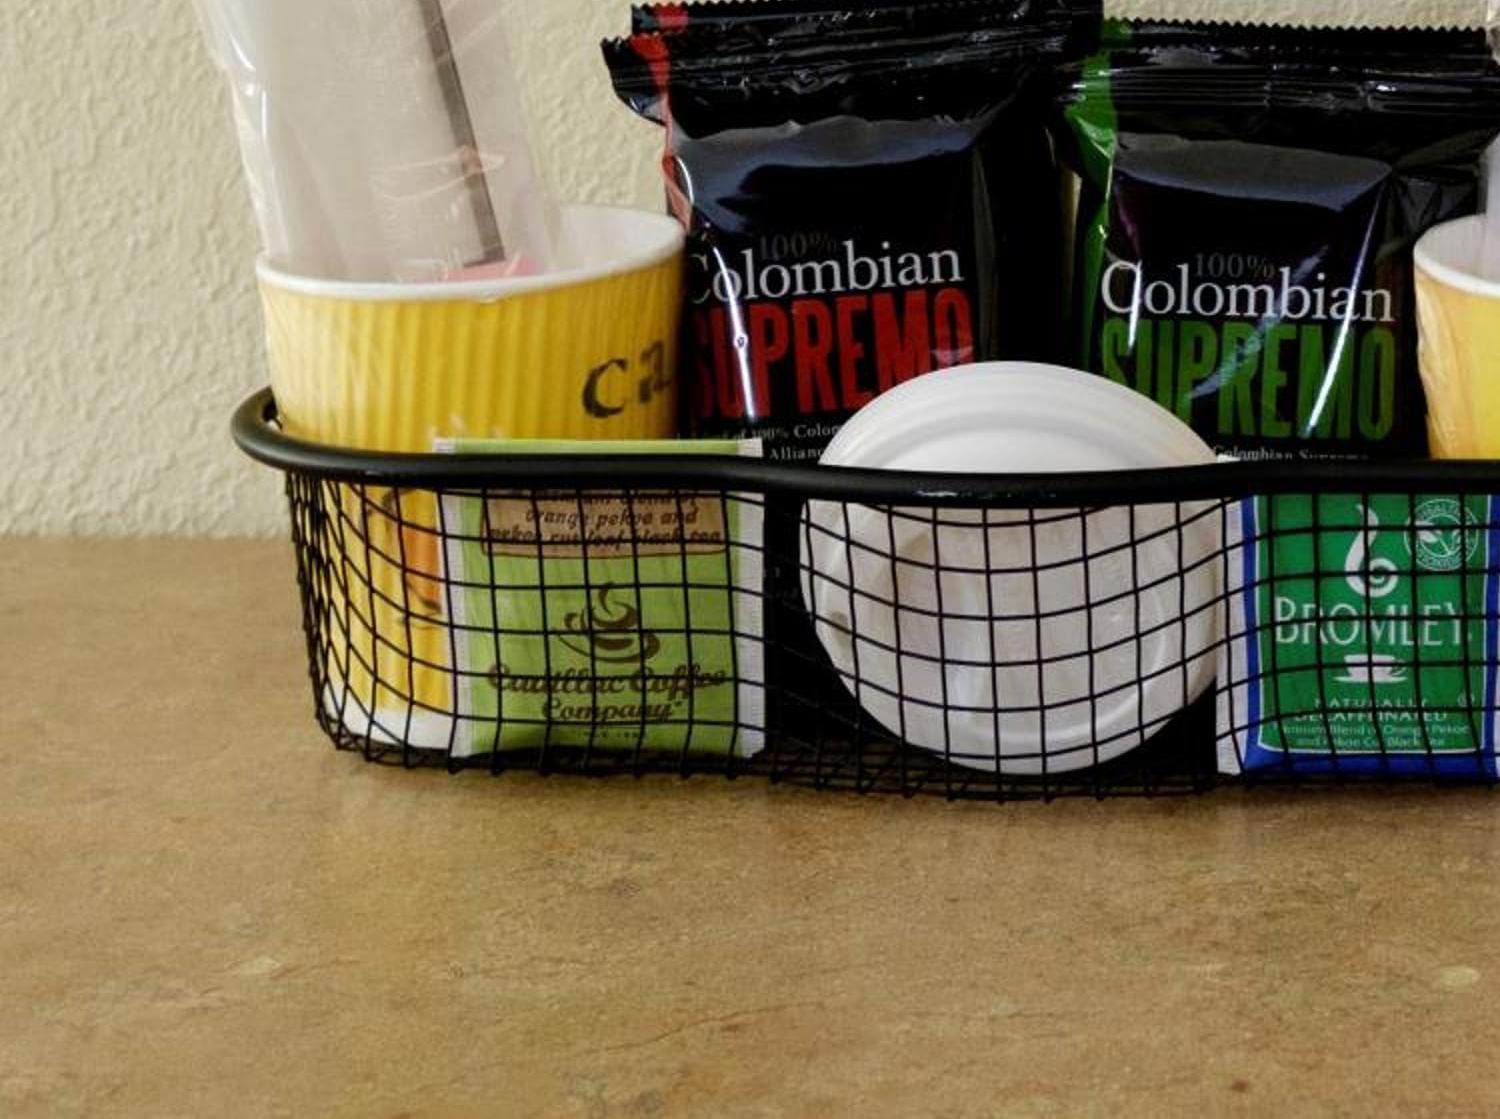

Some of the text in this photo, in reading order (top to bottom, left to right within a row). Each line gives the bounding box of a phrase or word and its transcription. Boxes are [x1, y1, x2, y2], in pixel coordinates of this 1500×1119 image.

[1102, 260, 1395, 322] Colombian
[1196, 254, 1275, 278] 100%
[1103, 320, 1396, 440] SUPREMO
